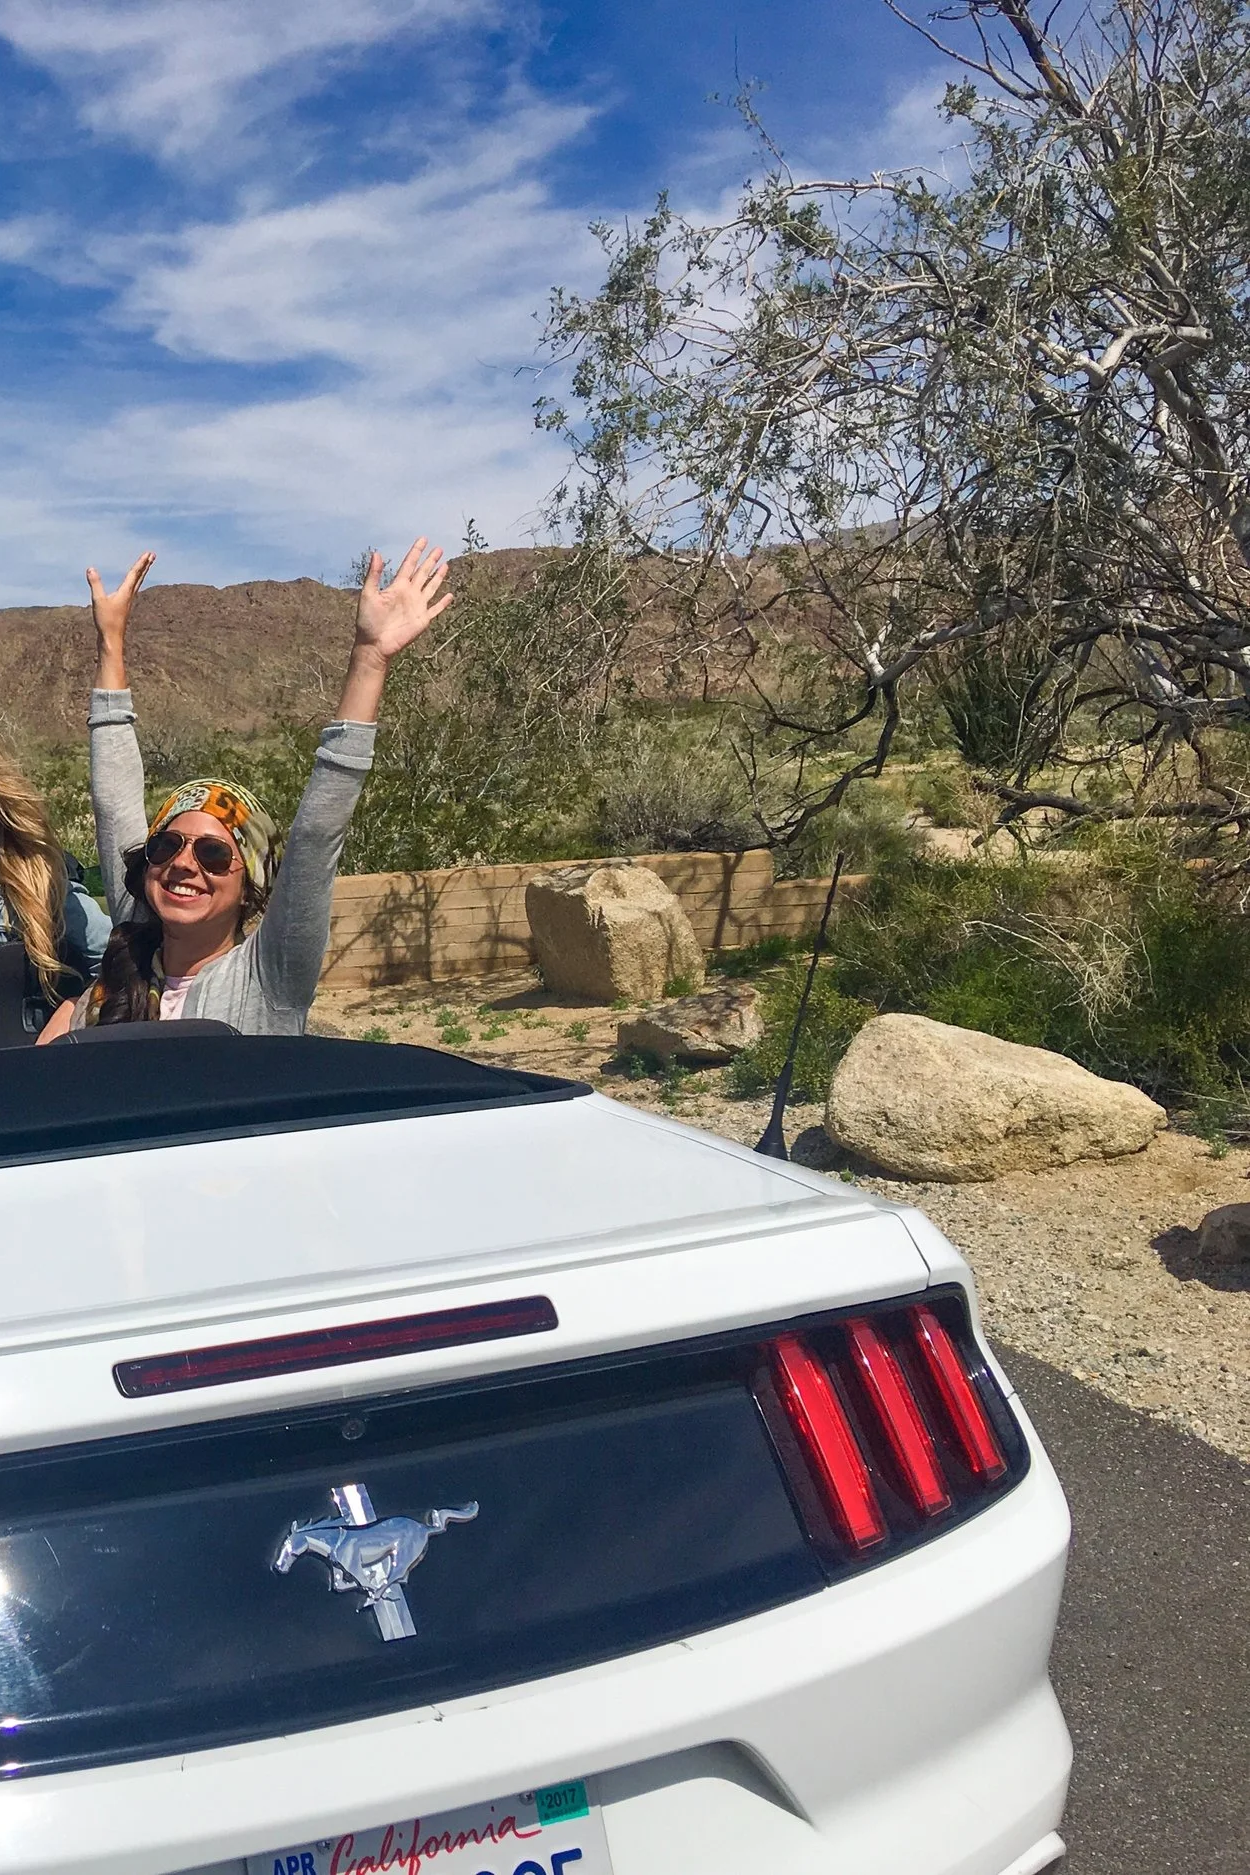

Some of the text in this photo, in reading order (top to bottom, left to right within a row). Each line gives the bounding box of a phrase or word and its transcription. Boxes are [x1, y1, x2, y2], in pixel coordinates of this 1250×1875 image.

[545, 1788, 576, 1809] 2017
[273, 1852, 317, 1875] APR
[330, 1806, 543, 1875] California
